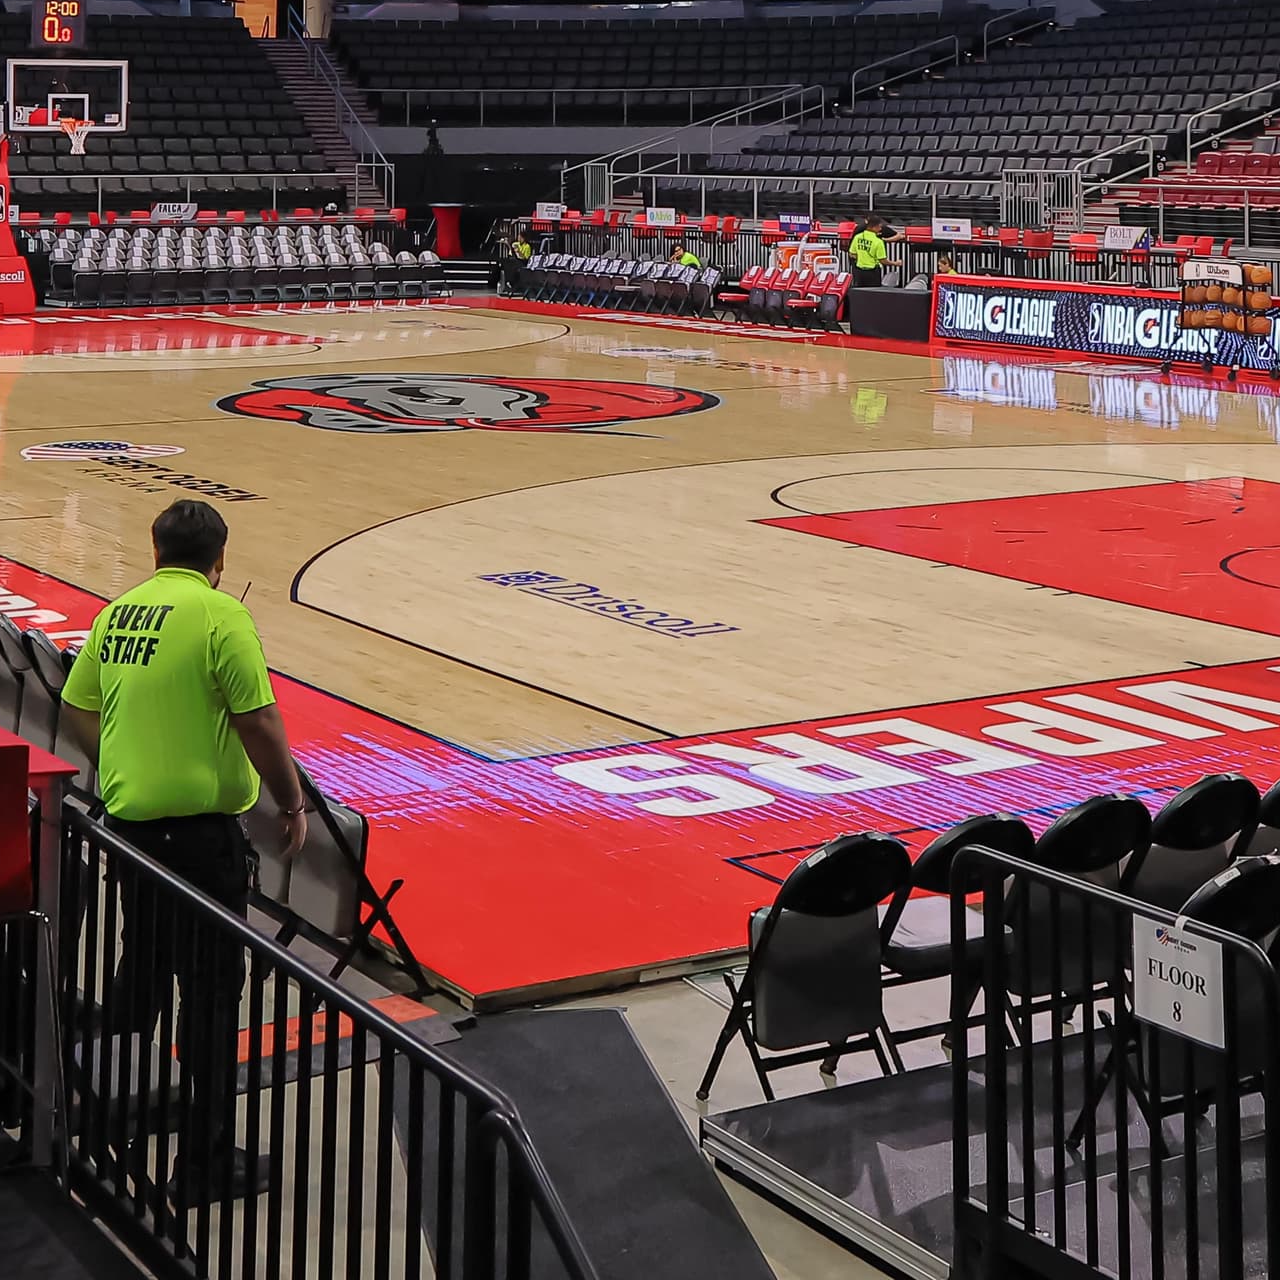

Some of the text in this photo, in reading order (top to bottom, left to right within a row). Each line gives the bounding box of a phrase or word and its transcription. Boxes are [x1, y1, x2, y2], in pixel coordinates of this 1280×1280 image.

[46, 0, 79, 18] 12:00
[1109, 227, 1133, 239] BOLT
[1206, 265, 1230, 276] Wilson
[955, 292, 1057, 339] NBA G LEAGUE
[1103, 302, 1135, 346] NBA
[1135, 306, 1162, 349] G
[75, 468, 169, 494] ARENA
[87, 455, 268, 502] BERT OGDEN
[108, 604, 175, 632] EVENT
[542, 577, 741, 638] Driscoll
[99, 636, 161, 667] STAFF
[1147, 957, 1207, 996] FLOOR
[1172, 1001, 1182, 1022] 8
